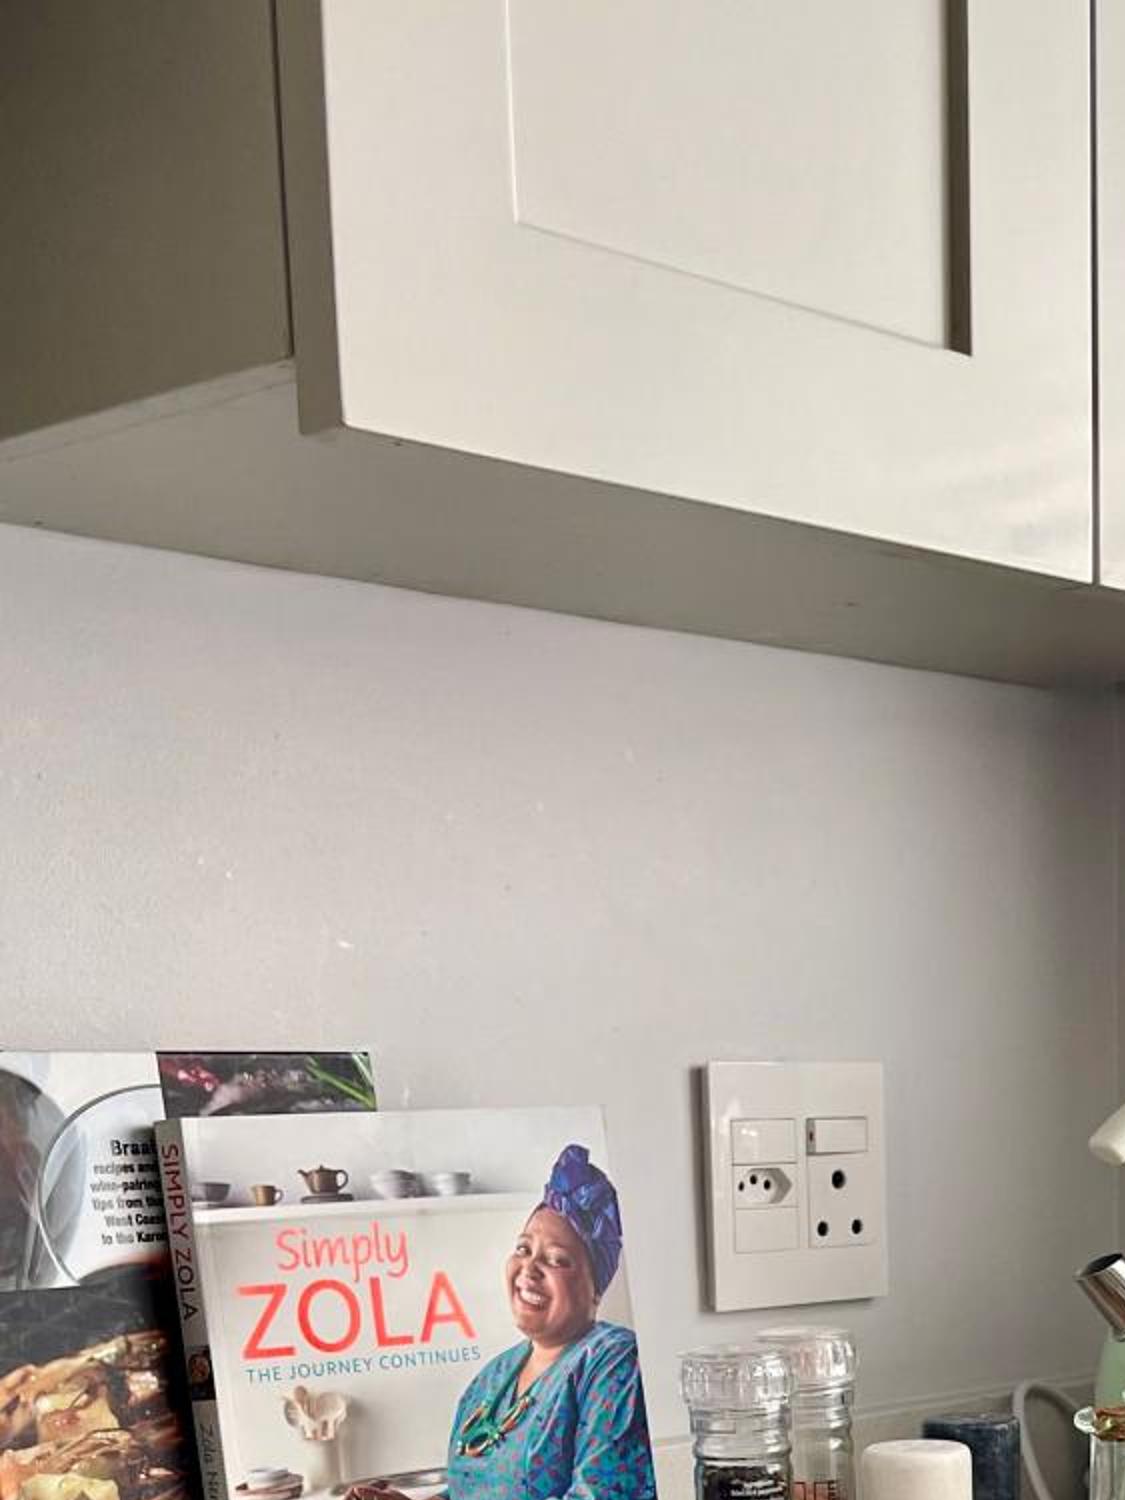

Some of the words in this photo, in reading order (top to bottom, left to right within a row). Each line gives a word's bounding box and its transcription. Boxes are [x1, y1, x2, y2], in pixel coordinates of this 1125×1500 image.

[93, 1163, 135, 1176] recipes
[161, 1143, 190, 1240] SIMPLY
[117, 1196, 144, 1209] from
[101, 1234, 113, 1245] to
[116, 1232, 135, 1244] the
[276, 1220, 409, 1283] Simply
[175, 1248, 199, 1321] ZOLA
[236, 1271, 477, 1358] ZOLA
[245, 1365, 287, 1384] THE
[288, 1357, 374, 1380] JOURNEY
[378, 1345, 482, 1370] CONTINUES
